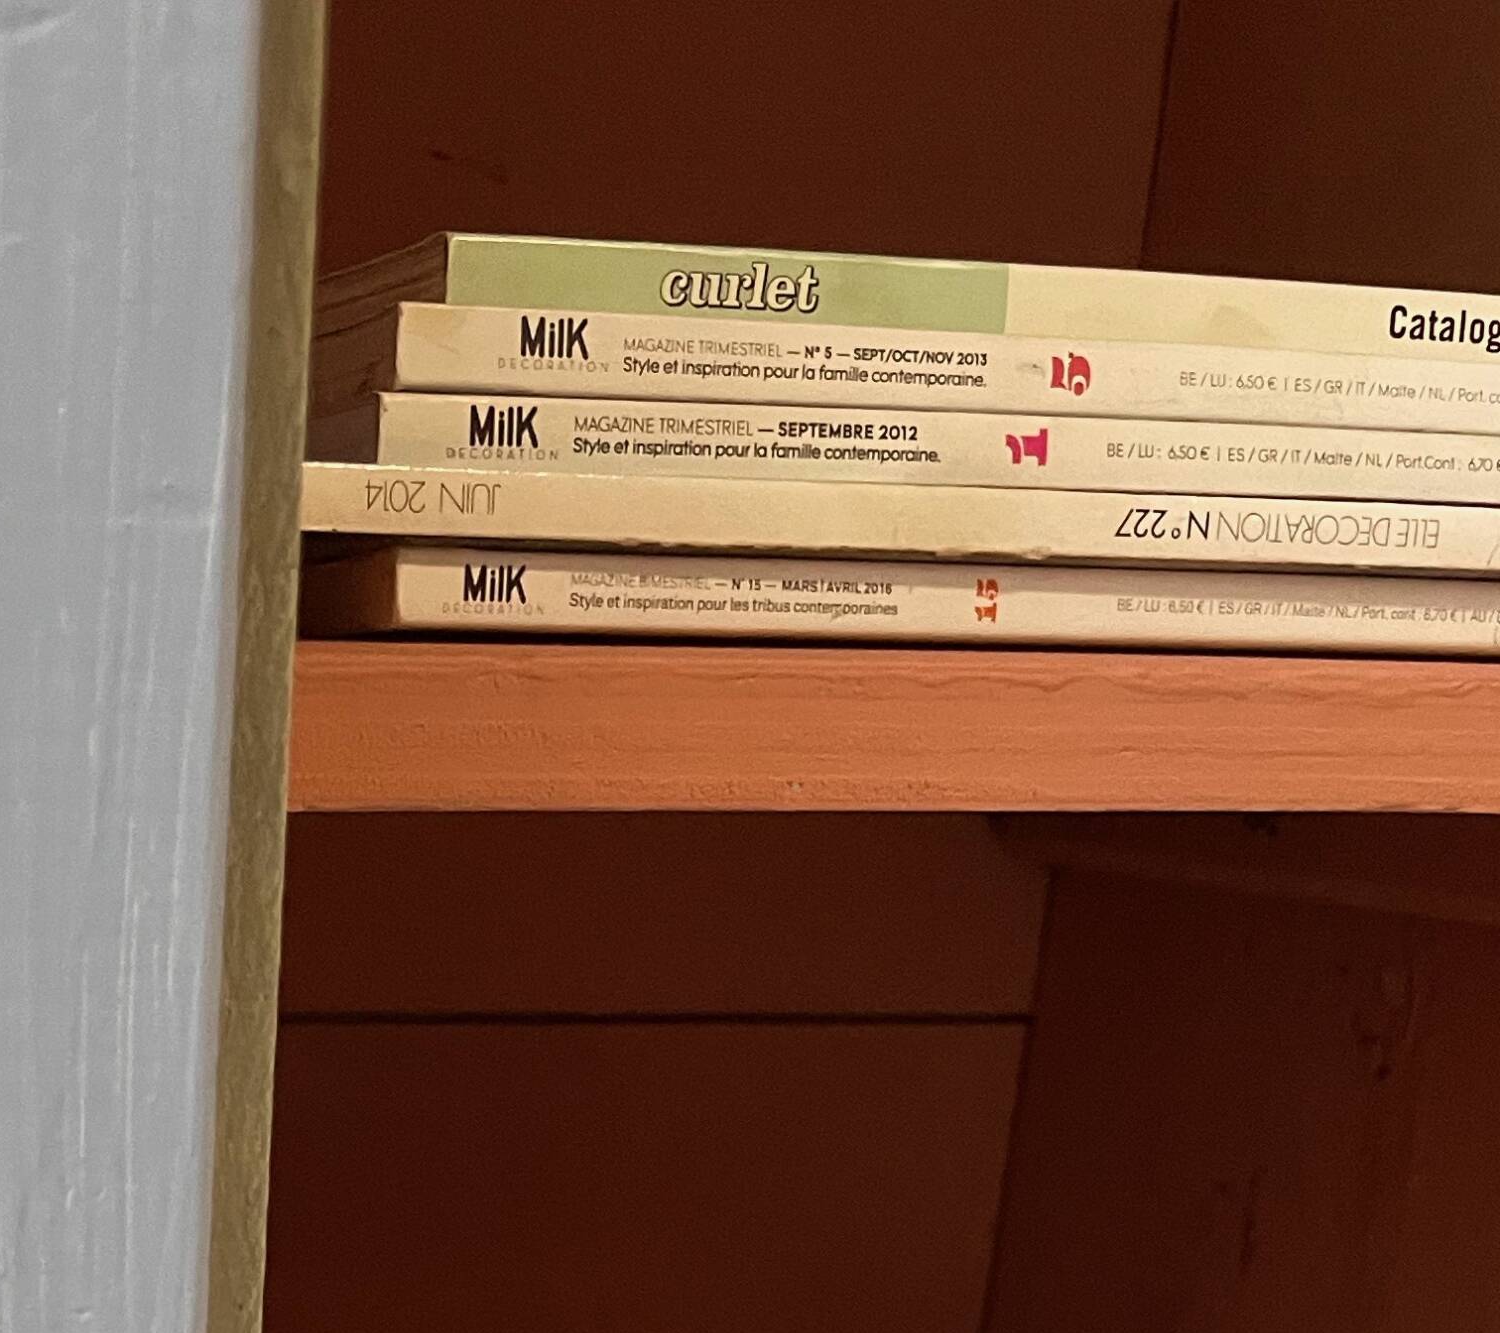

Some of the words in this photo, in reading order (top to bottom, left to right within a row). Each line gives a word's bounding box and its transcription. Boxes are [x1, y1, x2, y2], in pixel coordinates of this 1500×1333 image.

[660, 262, 819, 312] curlet
[623, 338, 695, 354] MAGAZINE
[699, 339, 783, 357] TRIMESTRIEL
[824, 346, 832, 360] 5
[853, 347, 954, 365] SEPT/OCT/NOV
[957, 352, 987, 366] 2013
[497, 357, 609, 373] DECORATION
[622, 356, 660, 376] Style
[663, 359, 679, 374] et
[682, 359, 760, 379] inspiration
[763, 365, 799, 381] pour
[802, 364, 816, 380] la
[819, 364, 869, 382] famille
[1379, 383, 1416, 399] Malte
[574, 416, 655, 433] MAGAZINE
[659, 417, 753, 436] TRIMESTRIEL
[778, 421, 874, 440] SEPTEMBRE
[878, 424, 918, 441] 2012
[446, 447, 557, 461] DECORATION
[573, 437, 610, 456] Style
[613, 440, 629, 454] et
[633, 439, 712, 458] inspiration
[715, 443, 750, 459] pour
[754, 442, 768, 458] la
[771, 442, 821, 459] famille
[1106, 442, 1124, 458] BE
[1228, 447, 1245, 462] ES
[1258, 448, 1277, 463] GR
[1314, 451, 1353, 466] Malte
[365, 479, 426, 514] 2014
[439, 482, 502, 515] JUIN
[1218, 511, 1391, 548] DECORATION
[1396, 518, 1440, 549] ELLE
[570, 573, 637, 588] MAGAZINE
[781, 579, 818, 593] MARS
[569, 592, 604, 611] Style
[606, 596, 620, 608] et
[623, 594, 694, 612] inspiration
[697, 599, 727, 614] pour
[730, 597, 749, 611] les
[752, 598, 790, 613] tribus
